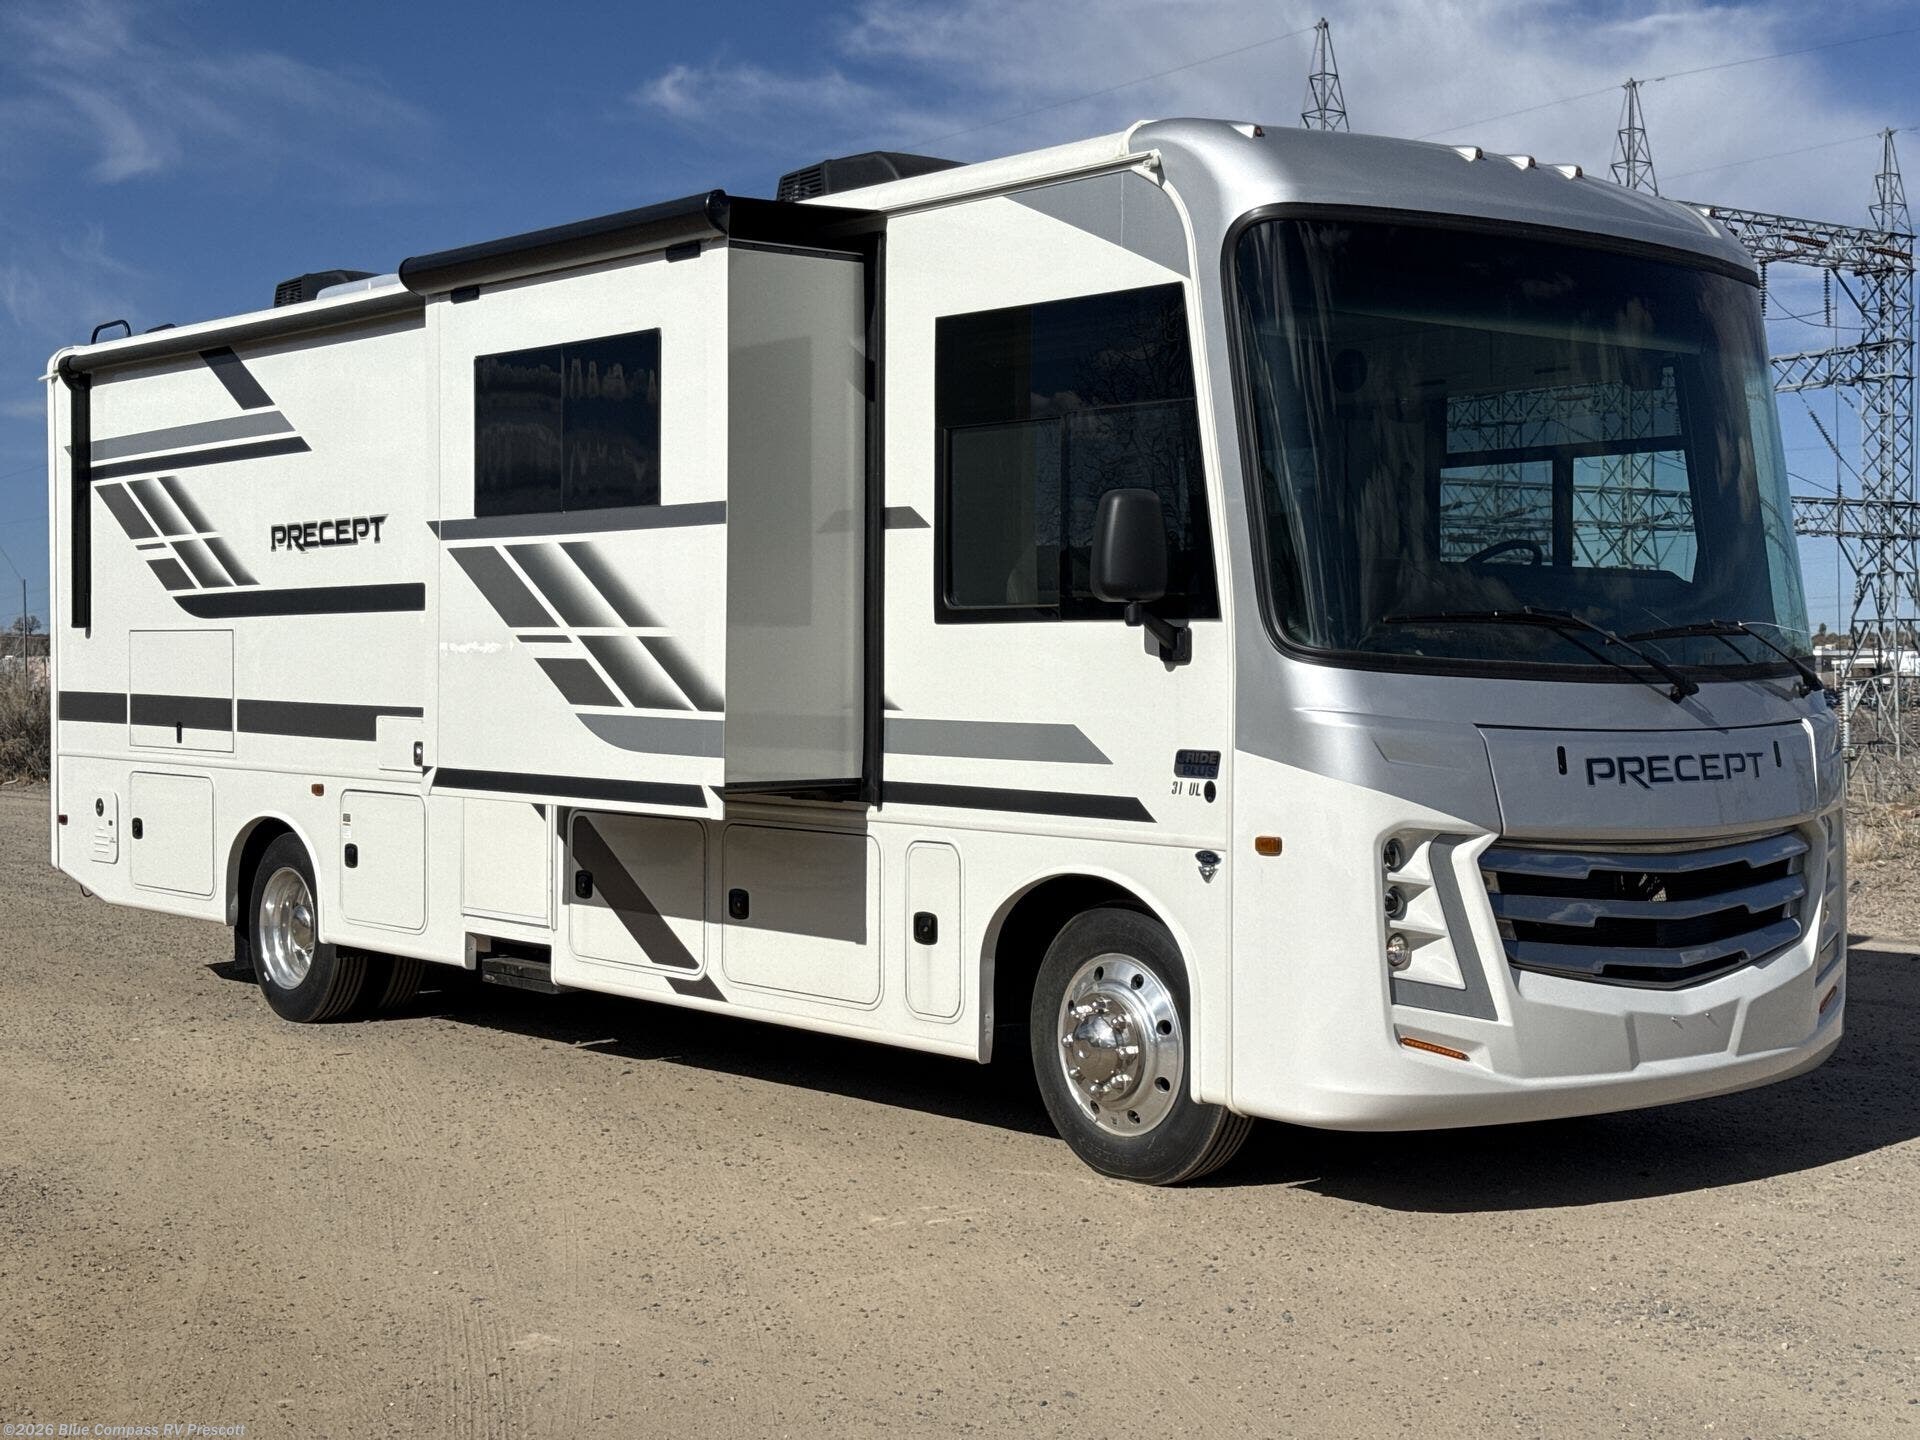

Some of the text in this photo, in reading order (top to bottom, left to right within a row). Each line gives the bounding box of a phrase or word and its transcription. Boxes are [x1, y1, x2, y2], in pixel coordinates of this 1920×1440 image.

[270, 514, 389, 553] PRECEPT
[1171, 781, 1201, 796] 31 UL
[1586, 752, 1763, 789] PRECEPT
